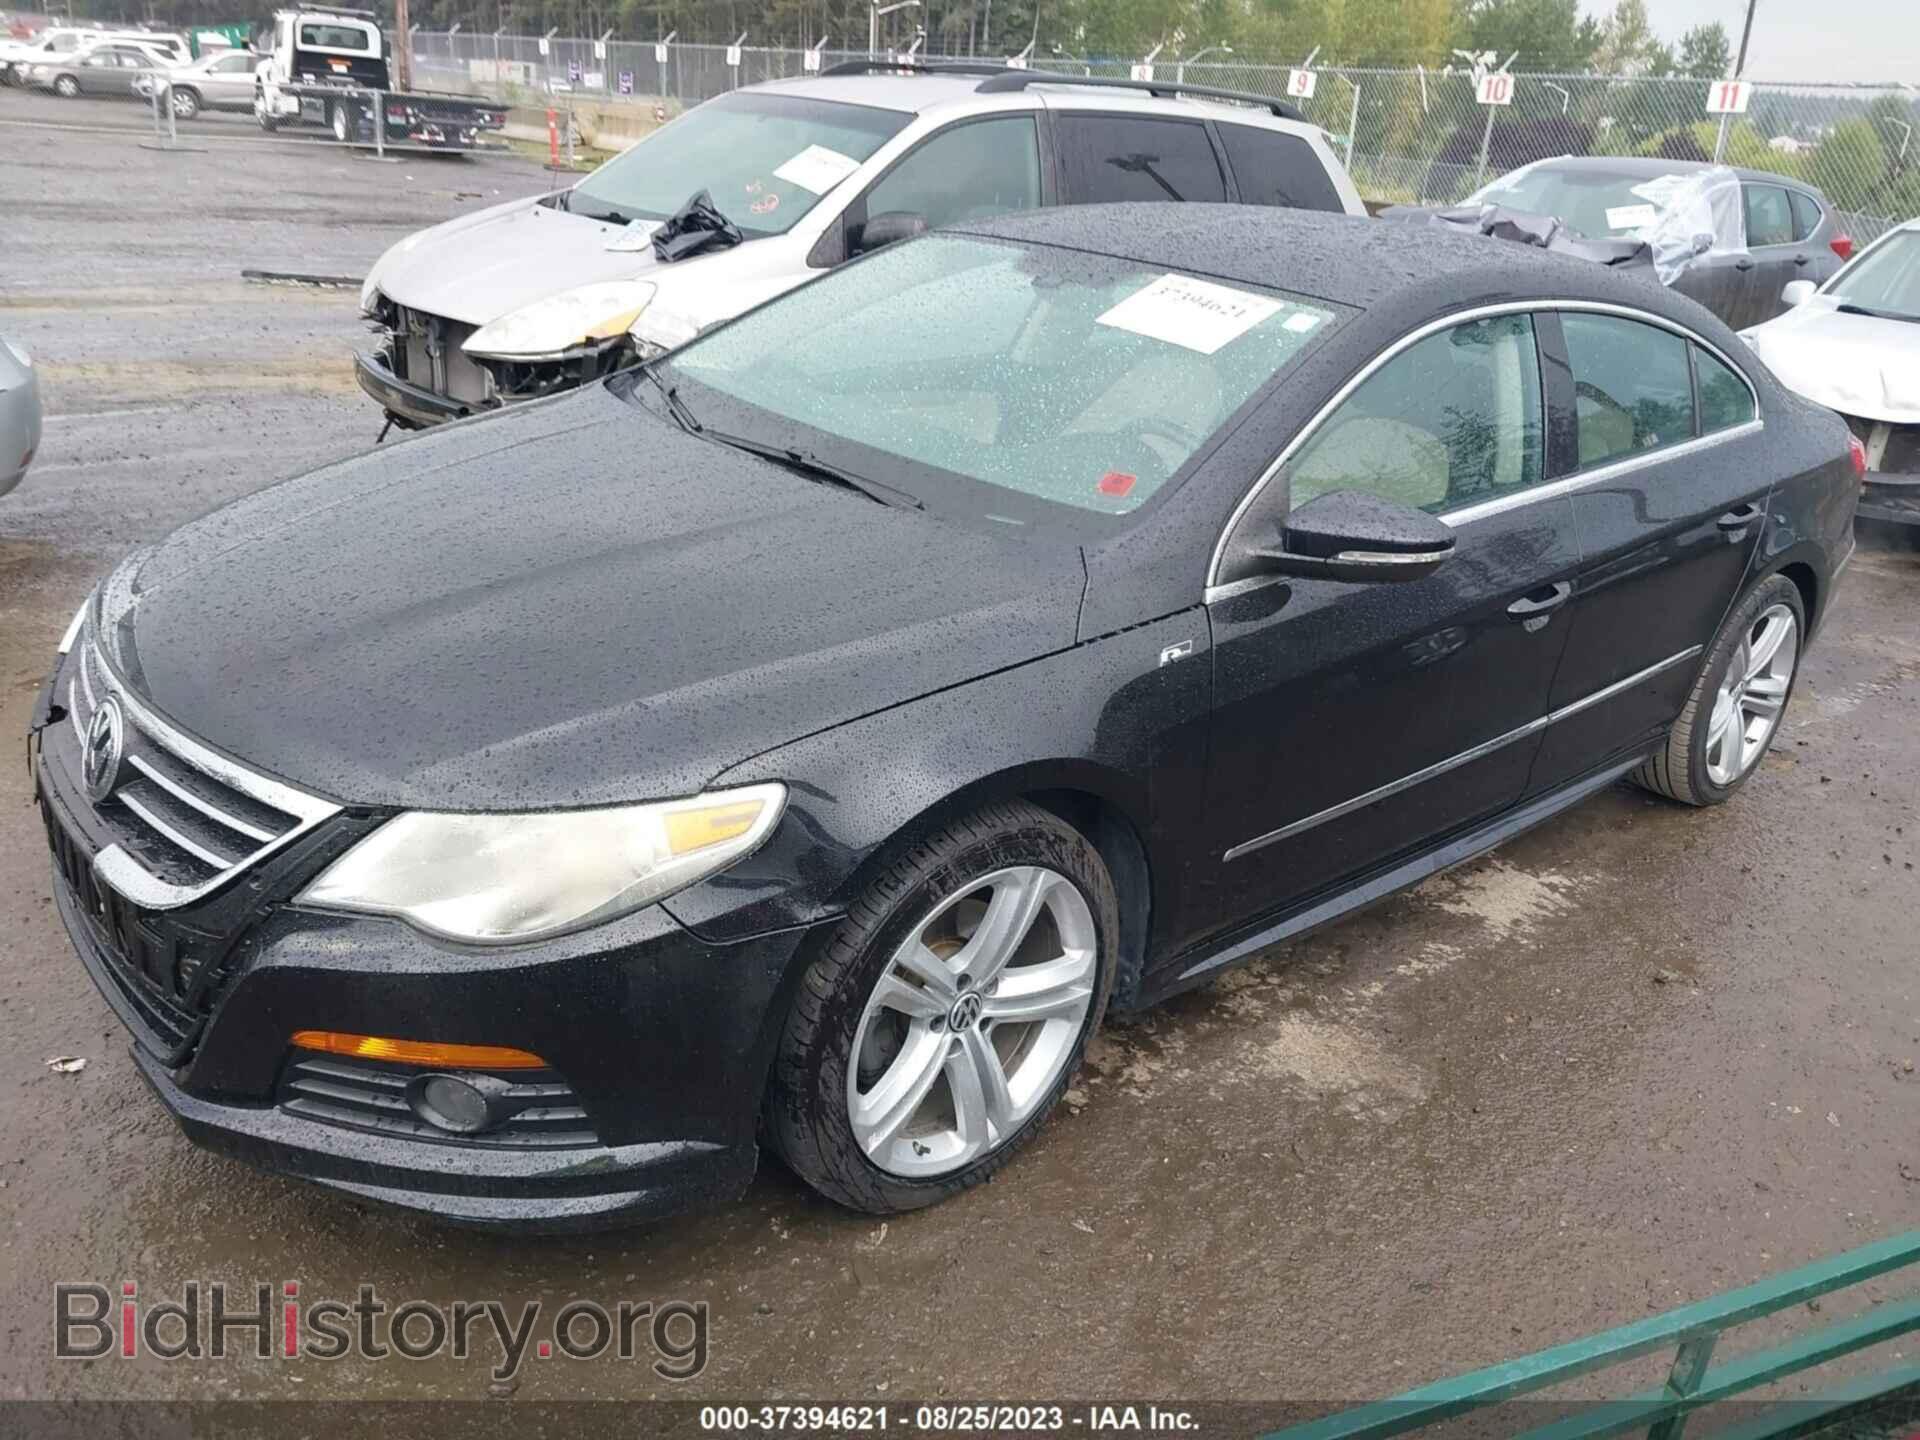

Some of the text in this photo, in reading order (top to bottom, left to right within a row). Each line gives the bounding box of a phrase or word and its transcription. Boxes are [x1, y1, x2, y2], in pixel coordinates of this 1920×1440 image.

[1296, 73, 1308, 94] 9
[1485, 77, 1508, 101] 10
[1719, 81, 1740, 110] 11
